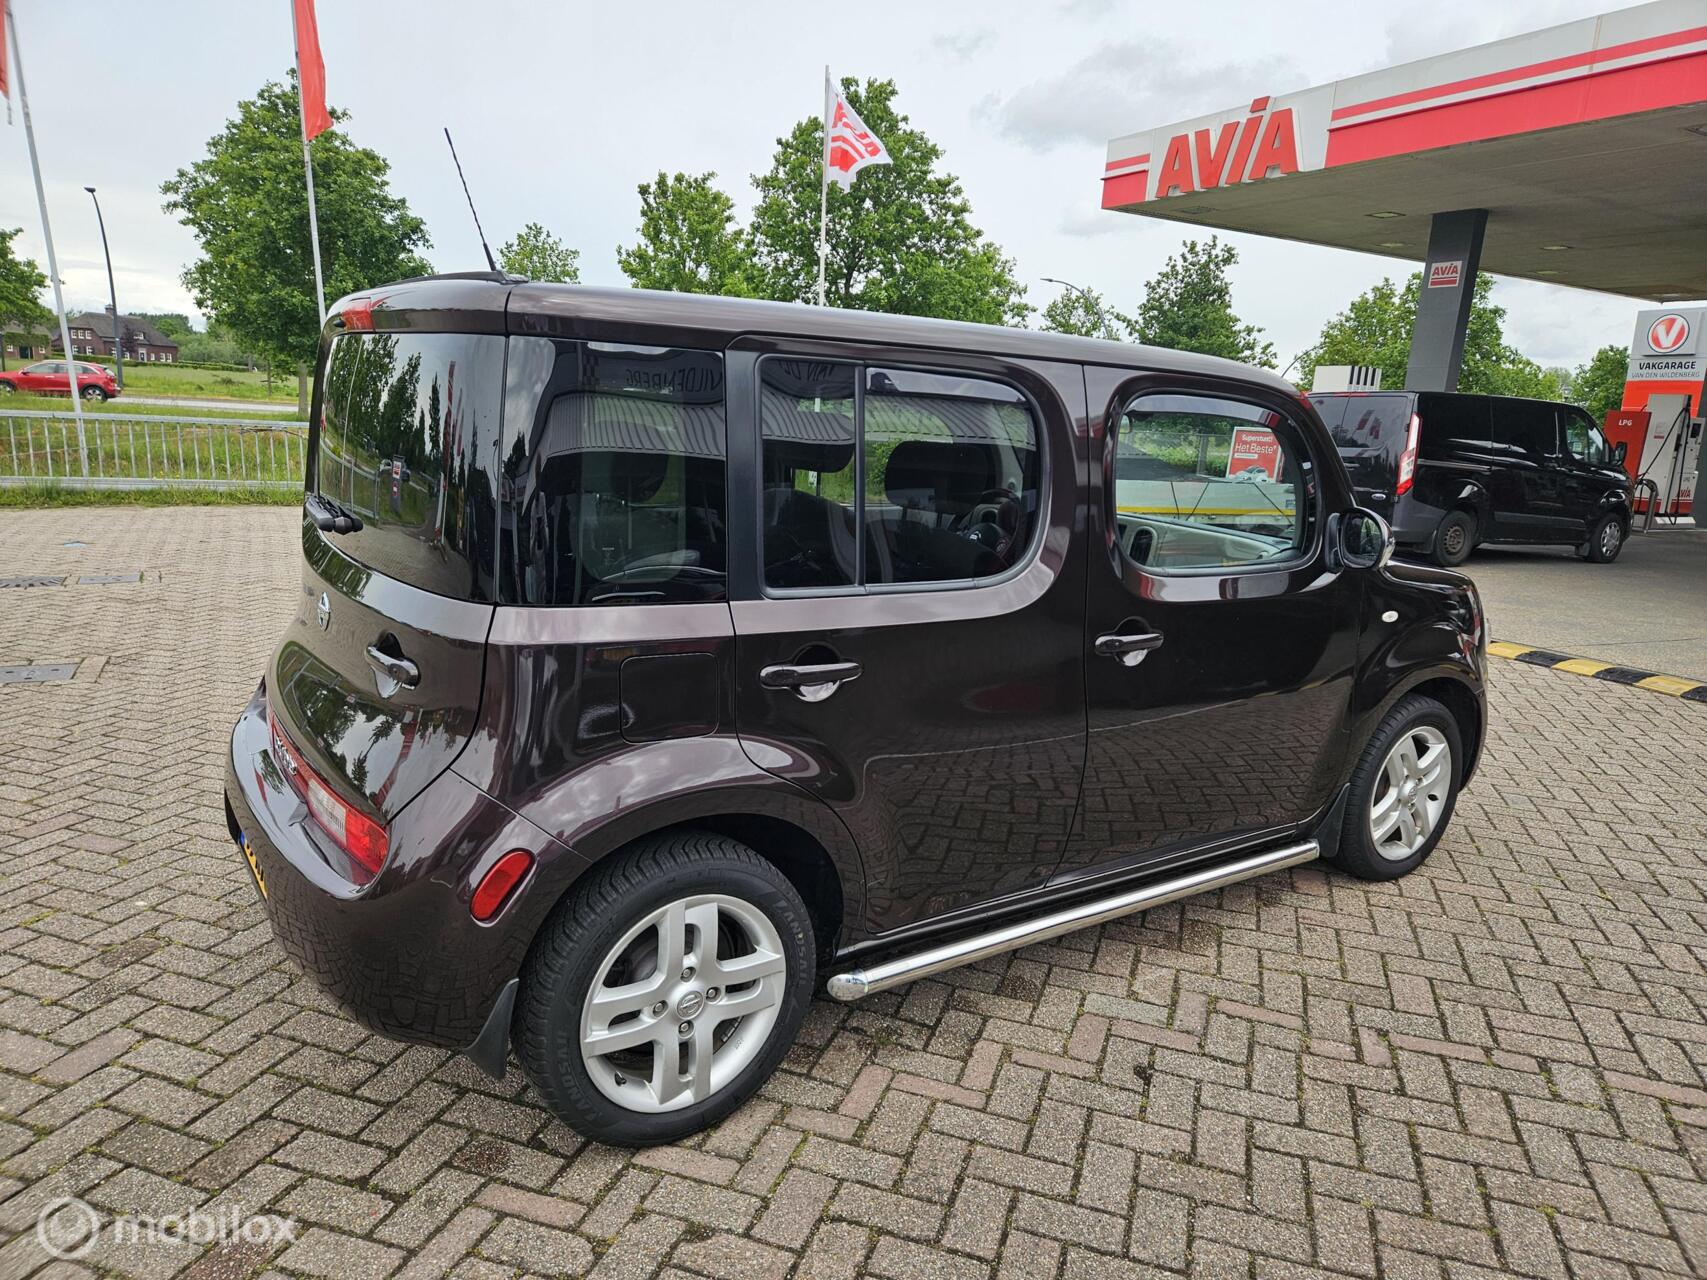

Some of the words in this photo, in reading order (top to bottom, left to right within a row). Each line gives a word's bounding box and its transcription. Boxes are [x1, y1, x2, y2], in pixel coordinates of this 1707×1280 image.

[1639, 361, 1697, 370] VAKGARAGE
[1618, 419, 1633, 427] LPG
[1234, 442, 1249, 452] Het
